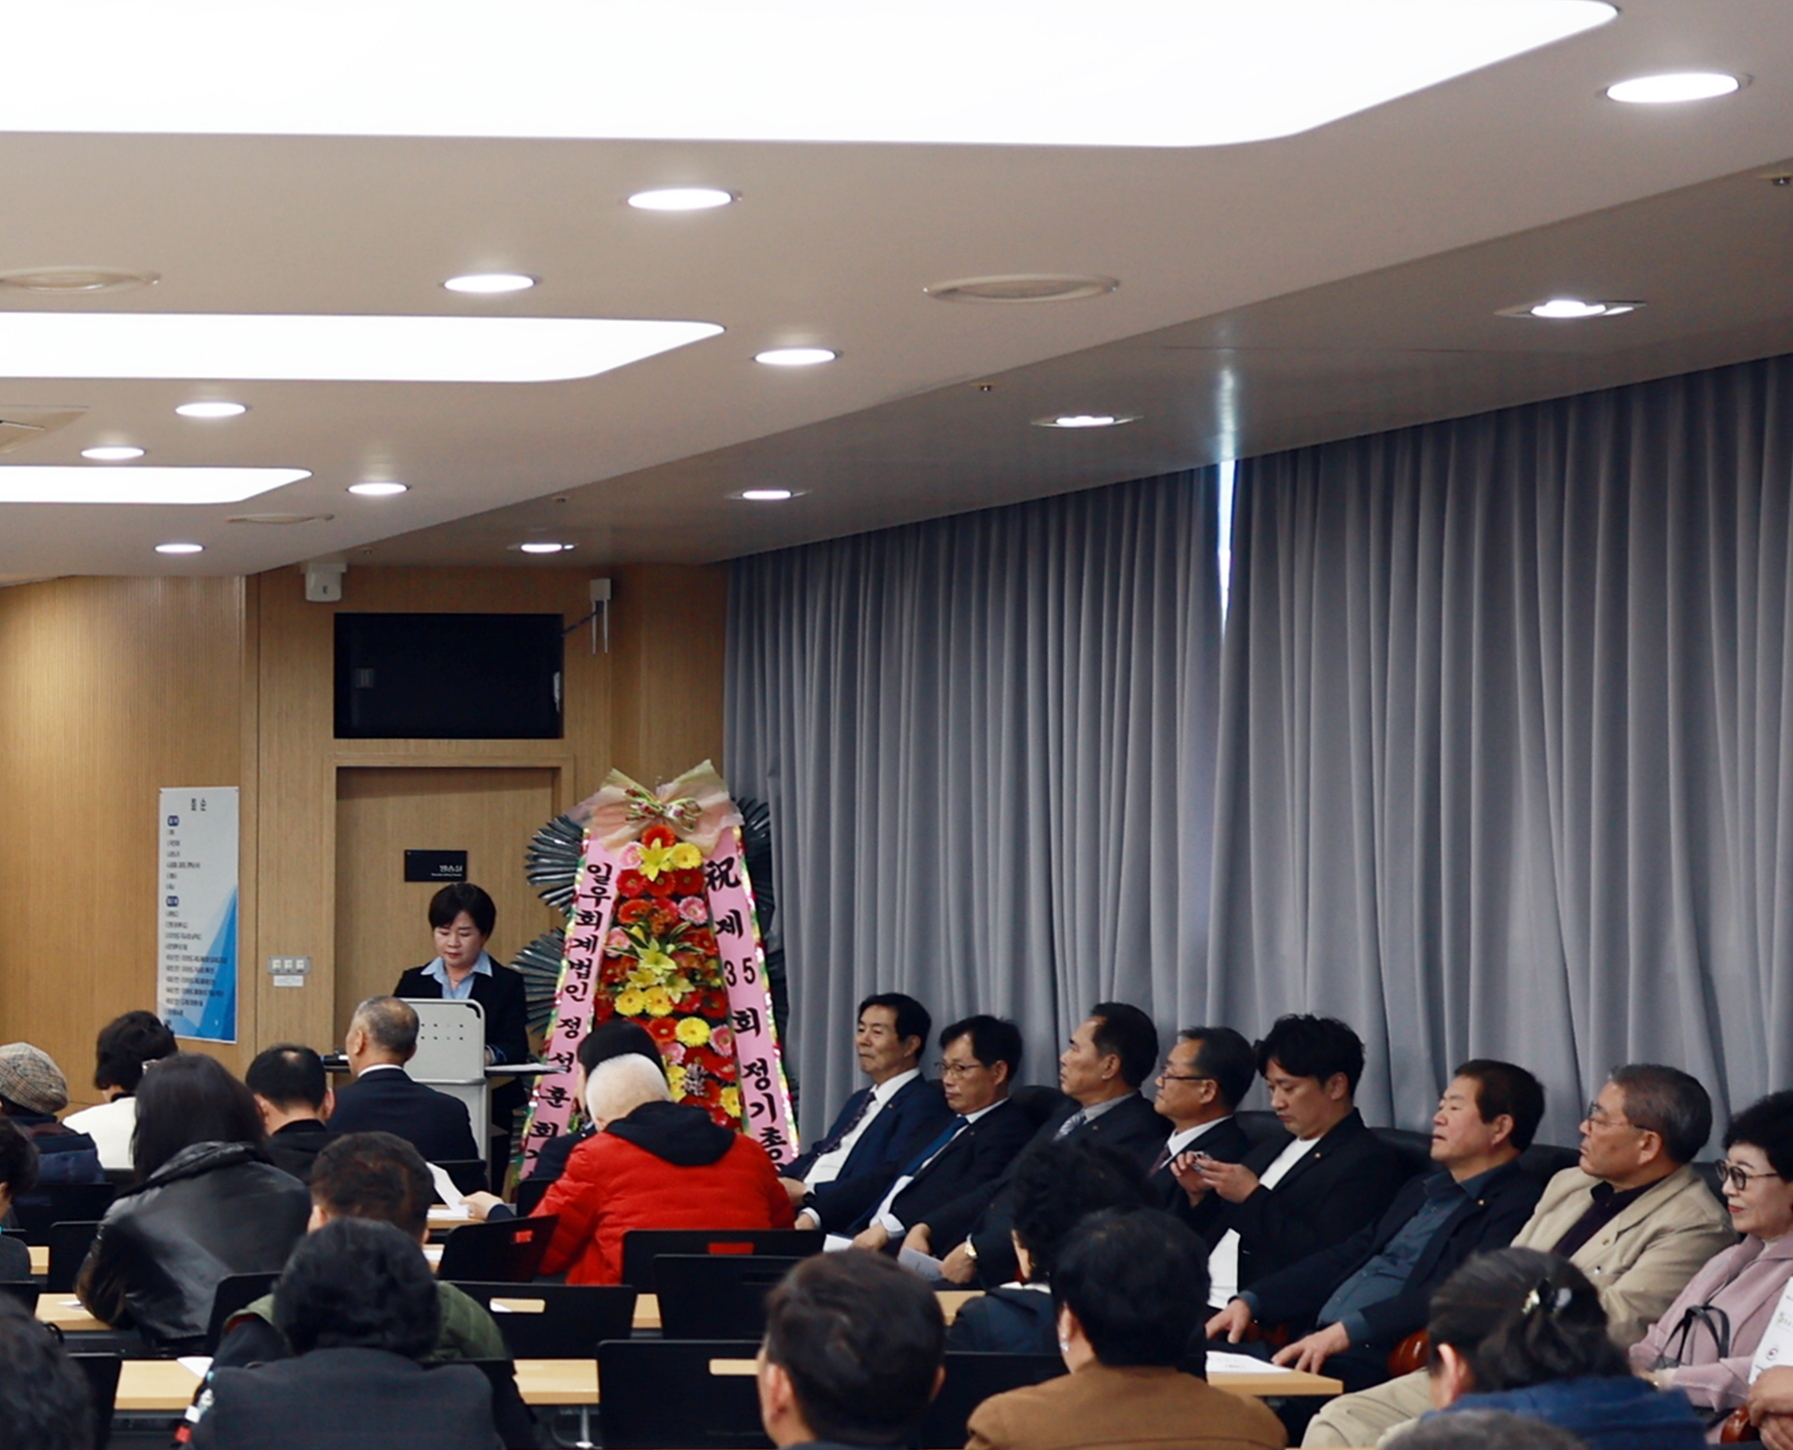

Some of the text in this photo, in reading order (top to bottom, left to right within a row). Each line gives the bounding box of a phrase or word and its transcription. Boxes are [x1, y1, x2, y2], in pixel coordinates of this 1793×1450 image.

[704, 857, 741, 890] 祝
[566, 861, 613, 1001] 일우회계법인
[741, 1059, 788, 1163] 정기총
